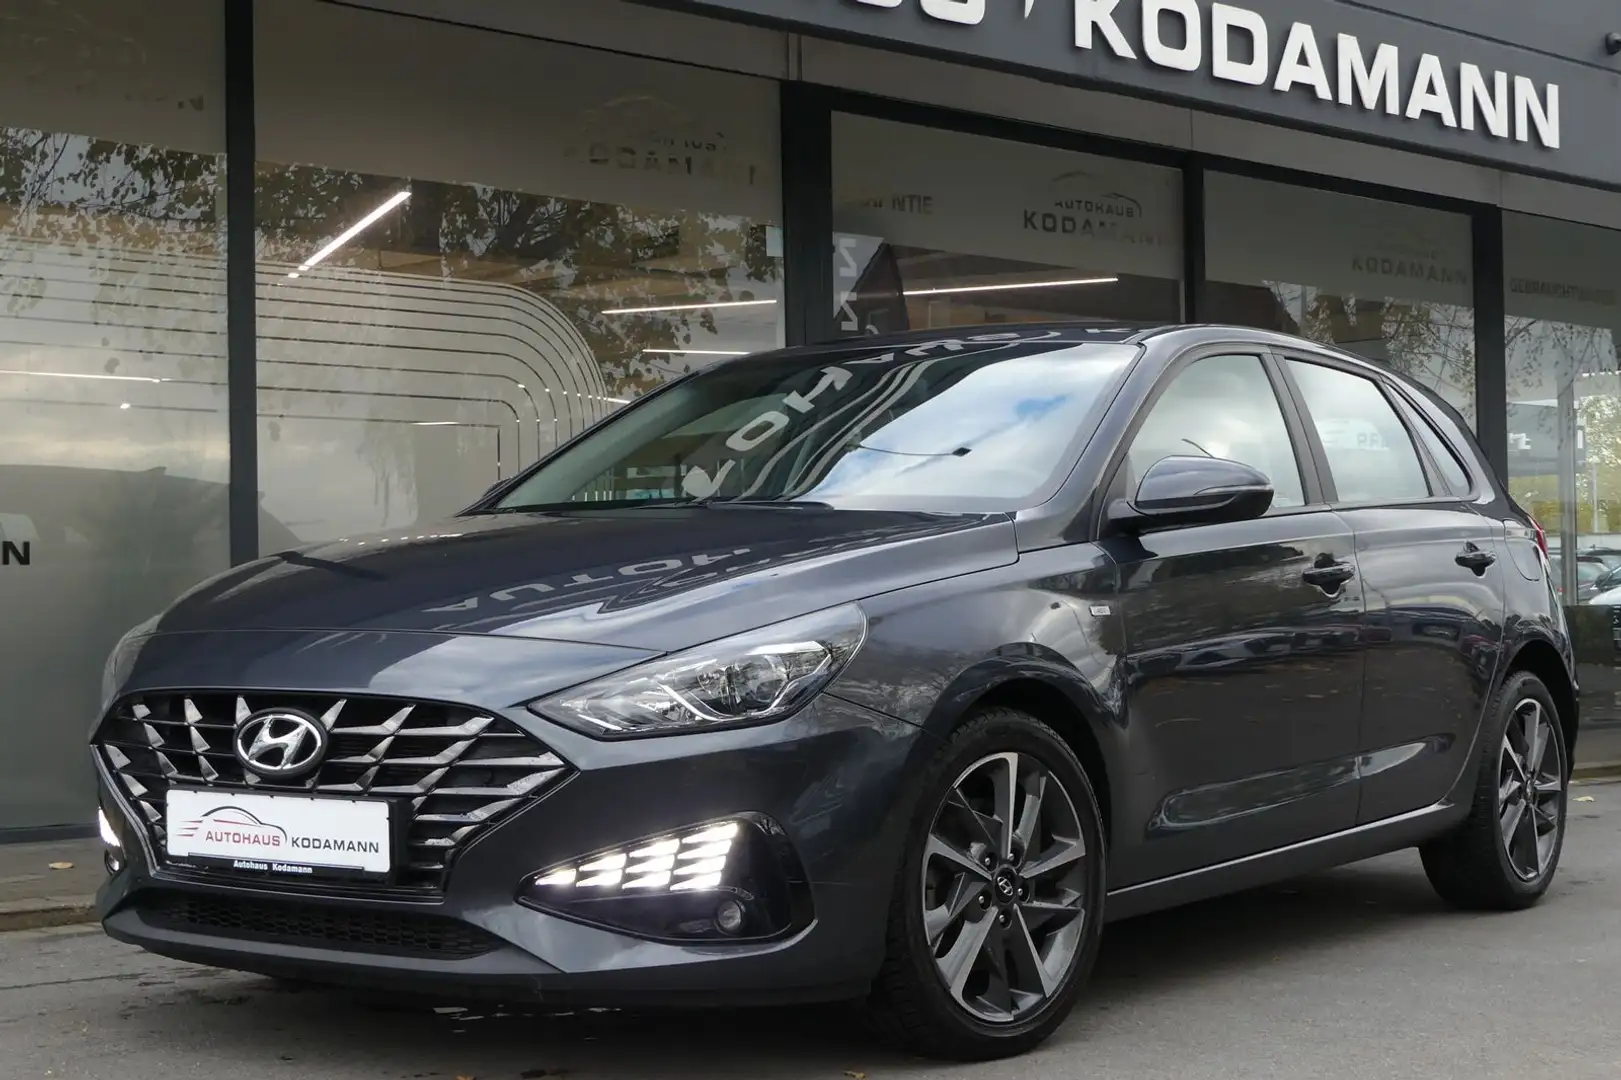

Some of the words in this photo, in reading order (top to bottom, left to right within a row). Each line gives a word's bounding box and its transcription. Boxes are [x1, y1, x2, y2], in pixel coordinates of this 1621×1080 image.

[1074, 0, 1560, 149] KODAMANN
[1351, 256, 1467, 285] KODAMANN
[205, 831, 281, 847] AUTOHAUS
[291, 836, 379, 854] KODAMANN
[233, 859, 268, 871] Autohaus
[272, 863, 313, 874] Kodamann
